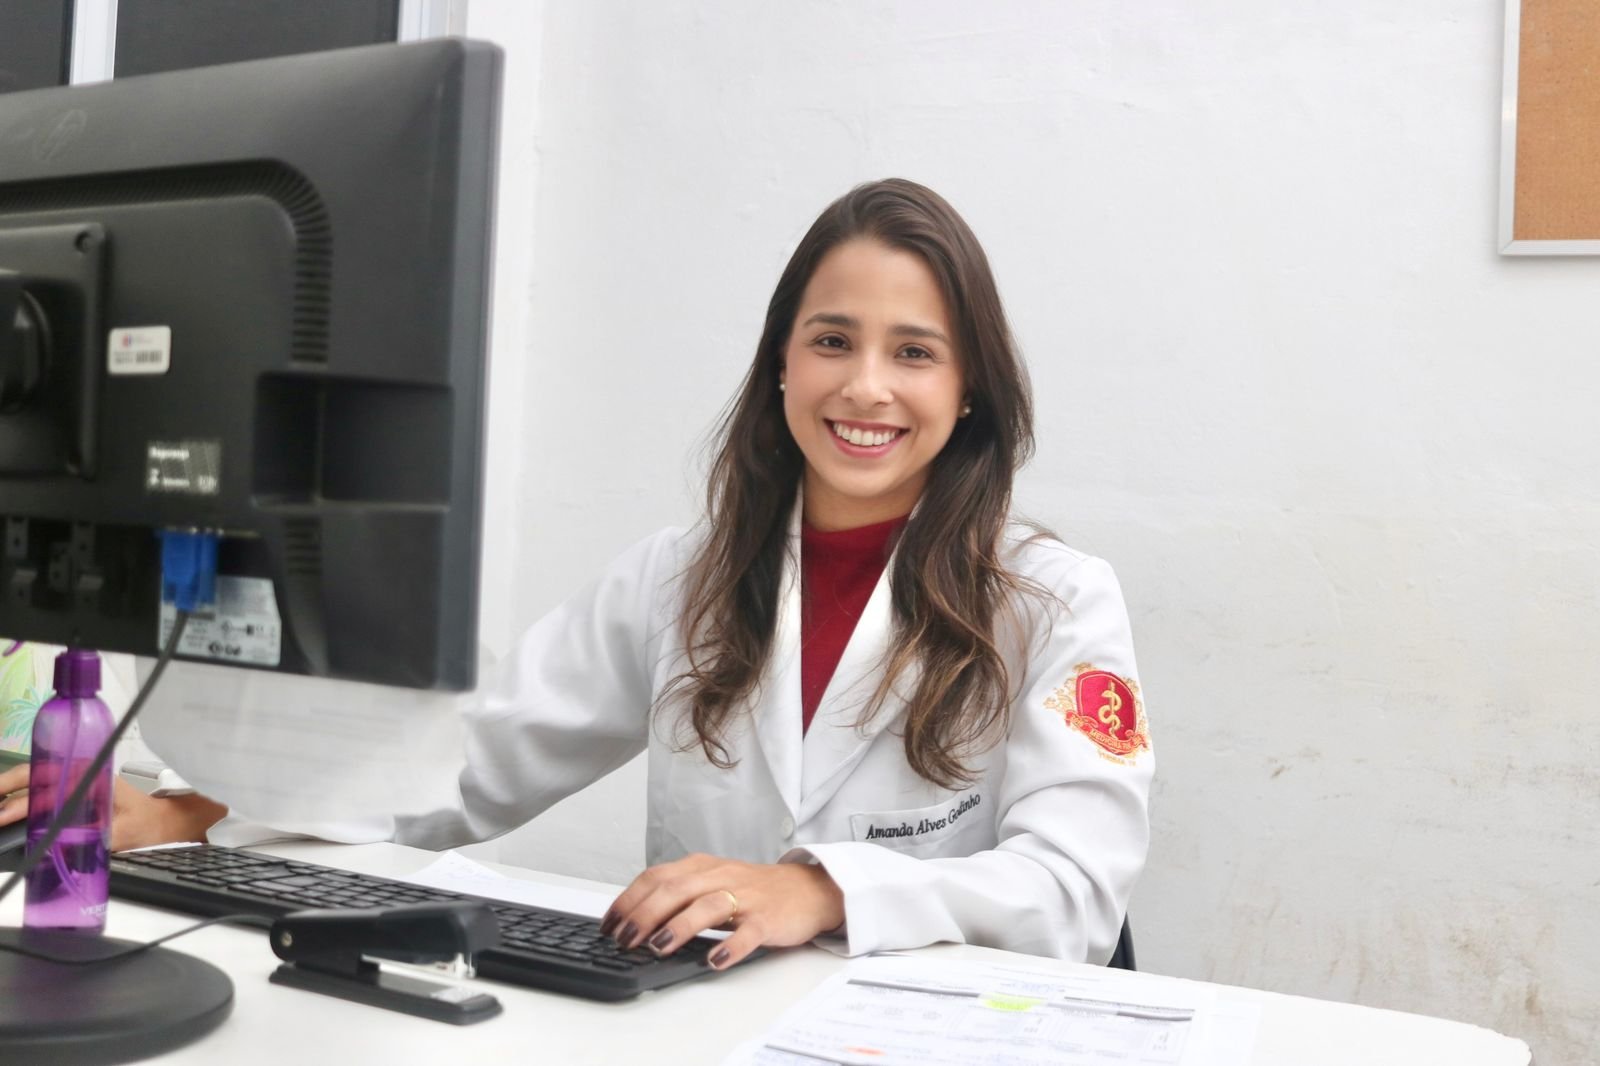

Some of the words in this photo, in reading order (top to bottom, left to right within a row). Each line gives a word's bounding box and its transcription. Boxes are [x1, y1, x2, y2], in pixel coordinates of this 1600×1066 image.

[866, 822, 914, 840] Amanda
[915, 818, 947, 836] Alves
[948, 793, 981, 824] Godinho
